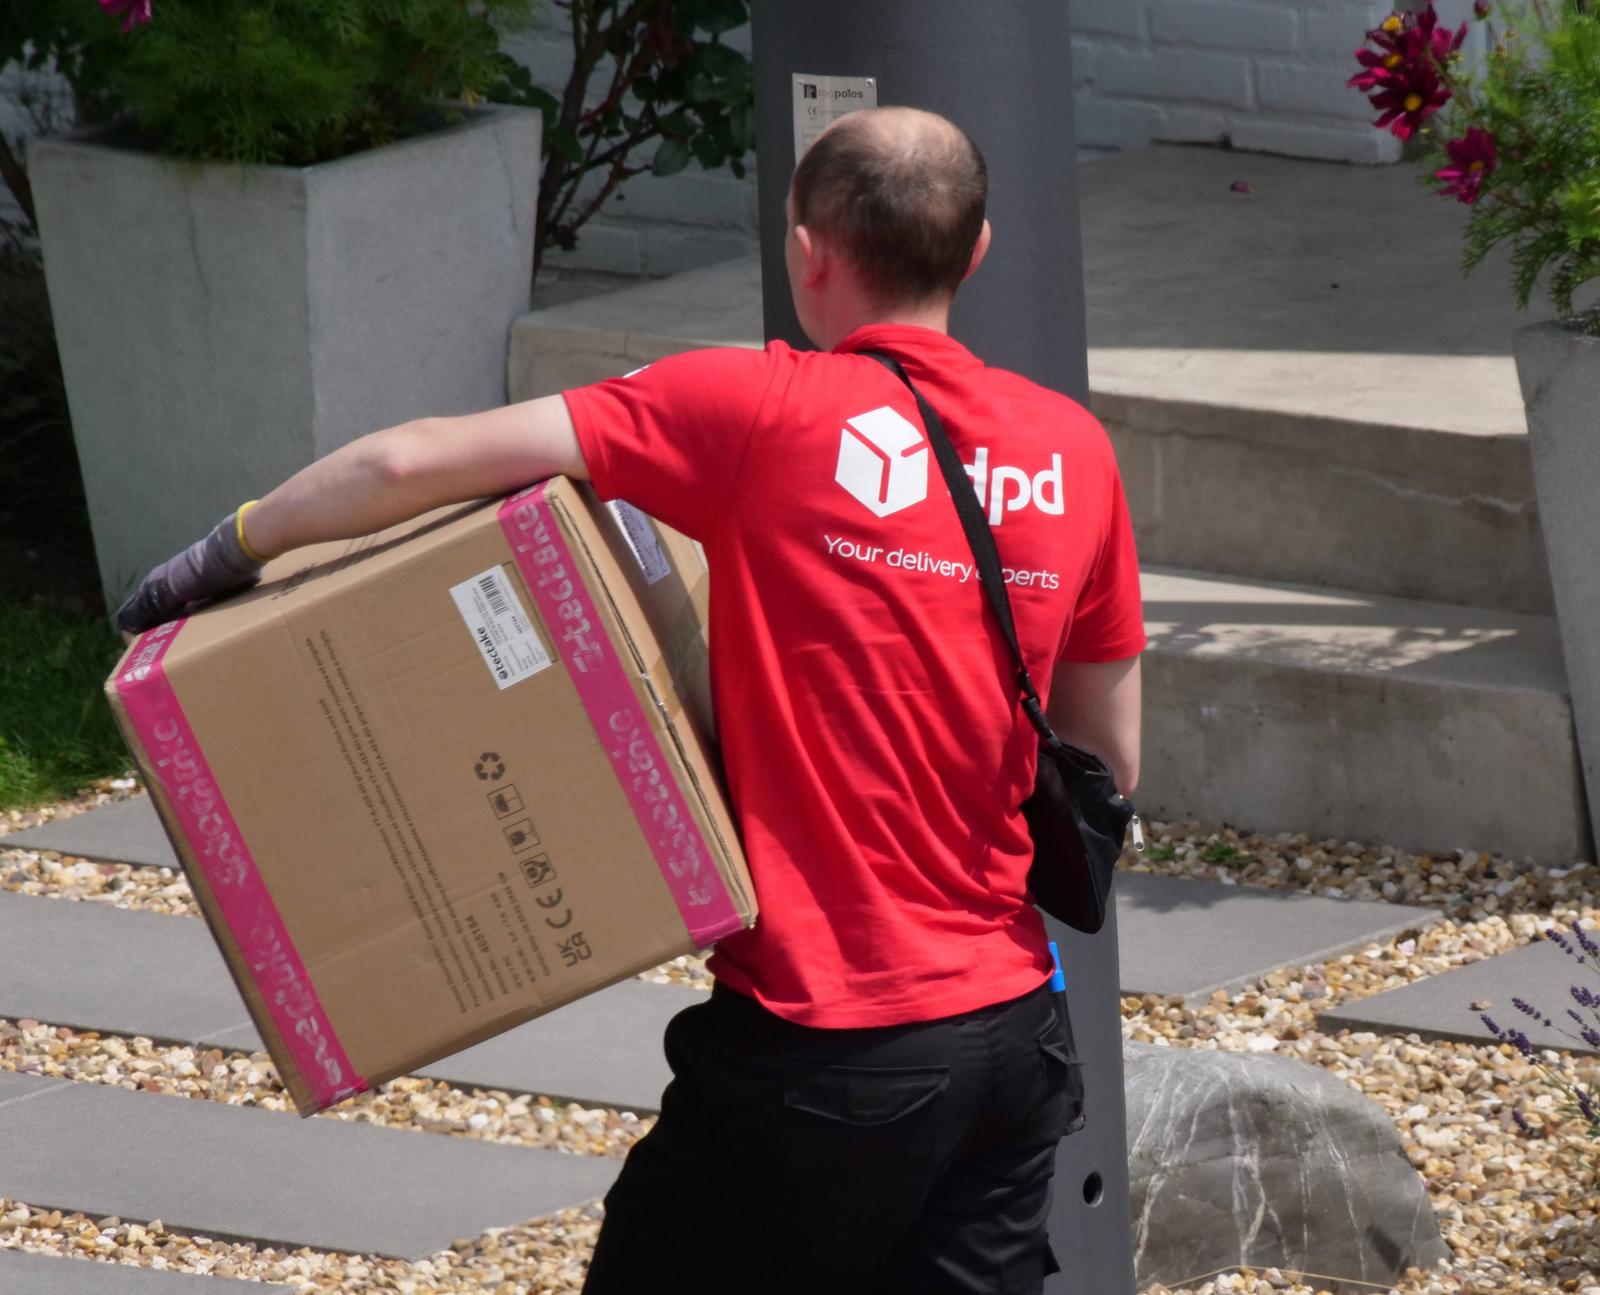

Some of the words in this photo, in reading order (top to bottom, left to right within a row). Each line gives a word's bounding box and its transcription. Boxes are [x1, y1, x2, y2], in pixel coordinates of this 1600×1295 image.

[823, 534, 884, 563] Your
[886, 547, 972, 584] delivery
[976, 565, 1059, 590] perts
[535, 887, 572, 928] CE
[556, 939, 578, 967] UK
[570, 931, 591, 960] CA
